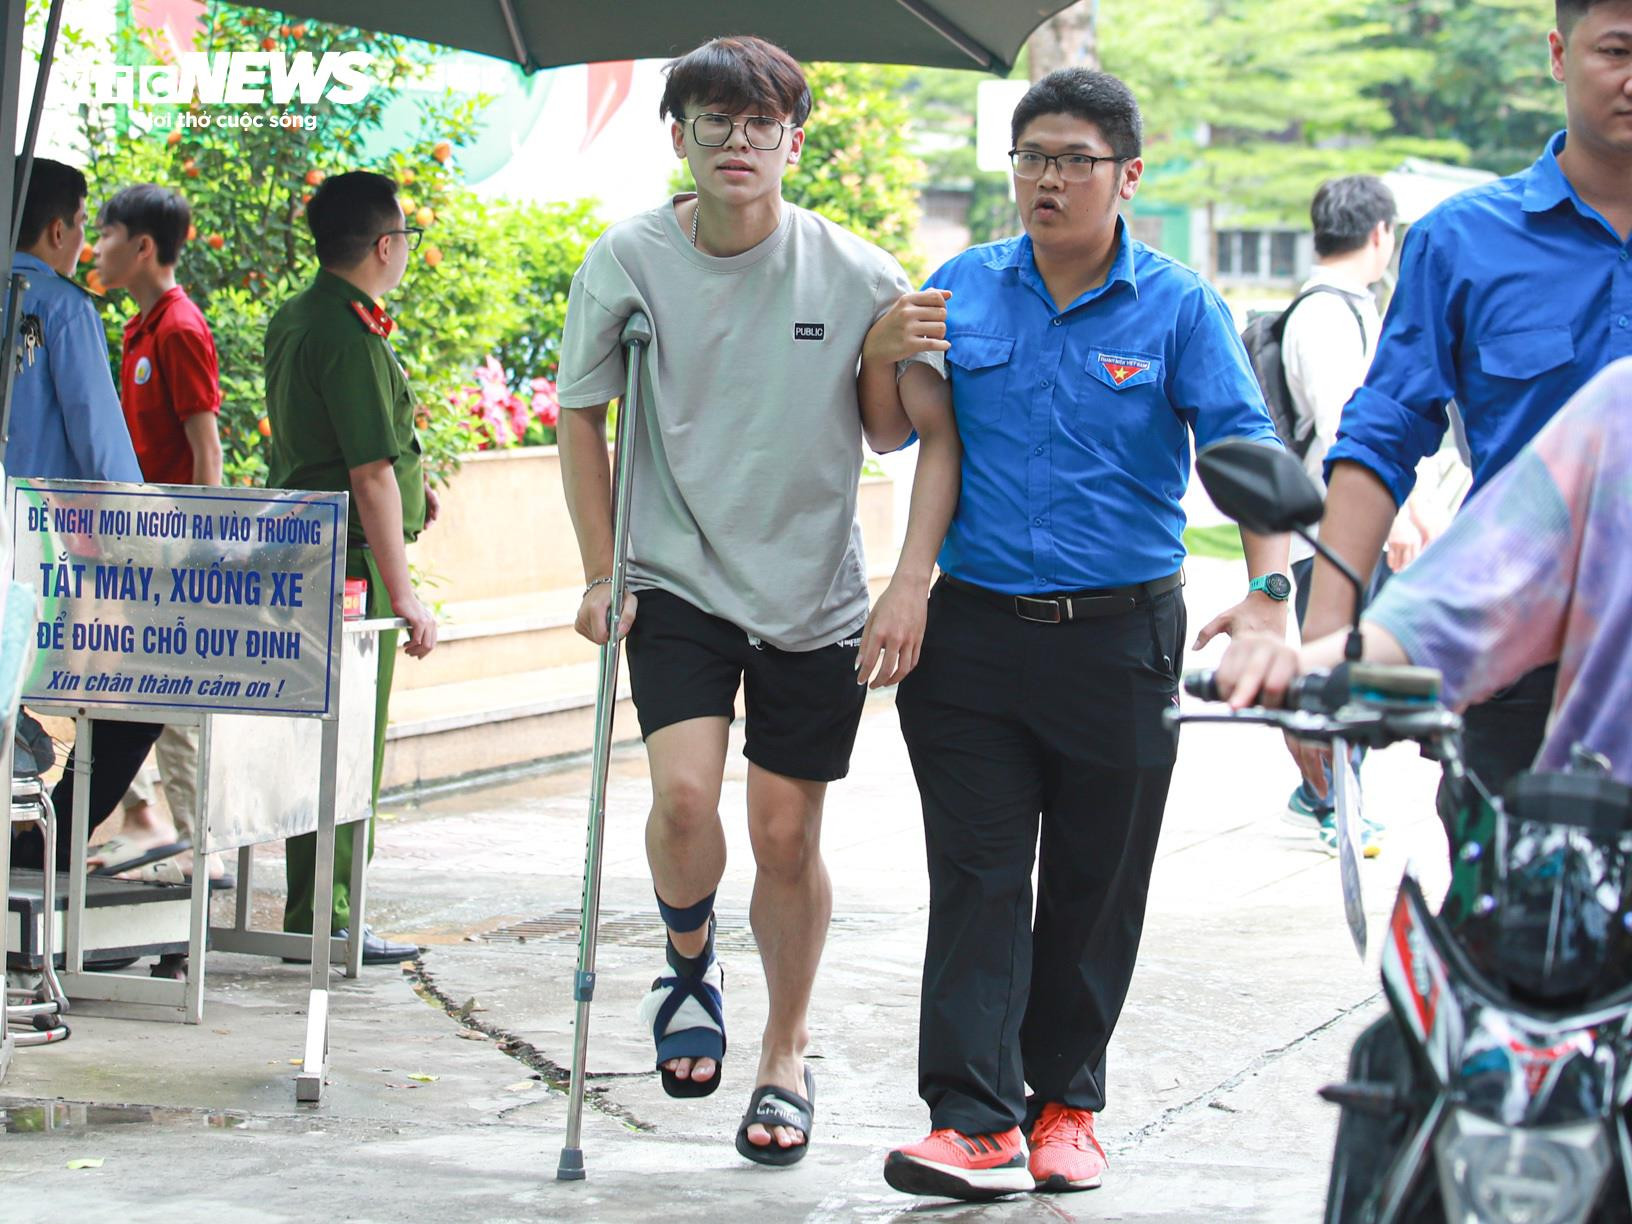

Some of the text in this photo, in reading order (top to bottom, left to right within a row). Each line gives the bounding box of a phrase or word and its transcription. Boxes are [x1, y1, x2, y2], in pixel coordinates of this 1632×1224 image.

[795, 327, 823, 337] PUBLIC
[54, 508, 94, 539] NGHỊ
[98, 510, 131, 541] MỌI
[136, 506, 187, 539] NGƯỜI
[192, 512, 214, 540] RA
[219, 510, 251, 542] VÀO
[256, 511, 321, 545] TRƯỜNG
[39, 551, 304, 608] TẮT MÁY, XUỐNG XE
[36, 610, 301, 665] ĐỂ ĐÚNG CHỖ QUY ĐỊNH
[46, 670, 81, 691] Xin
[84, 672, 134, 693] chân
[137, 674, 194, 695] thành
[197, 674, 241, 697] cảm
[245, 679, 271, 698] ơn
